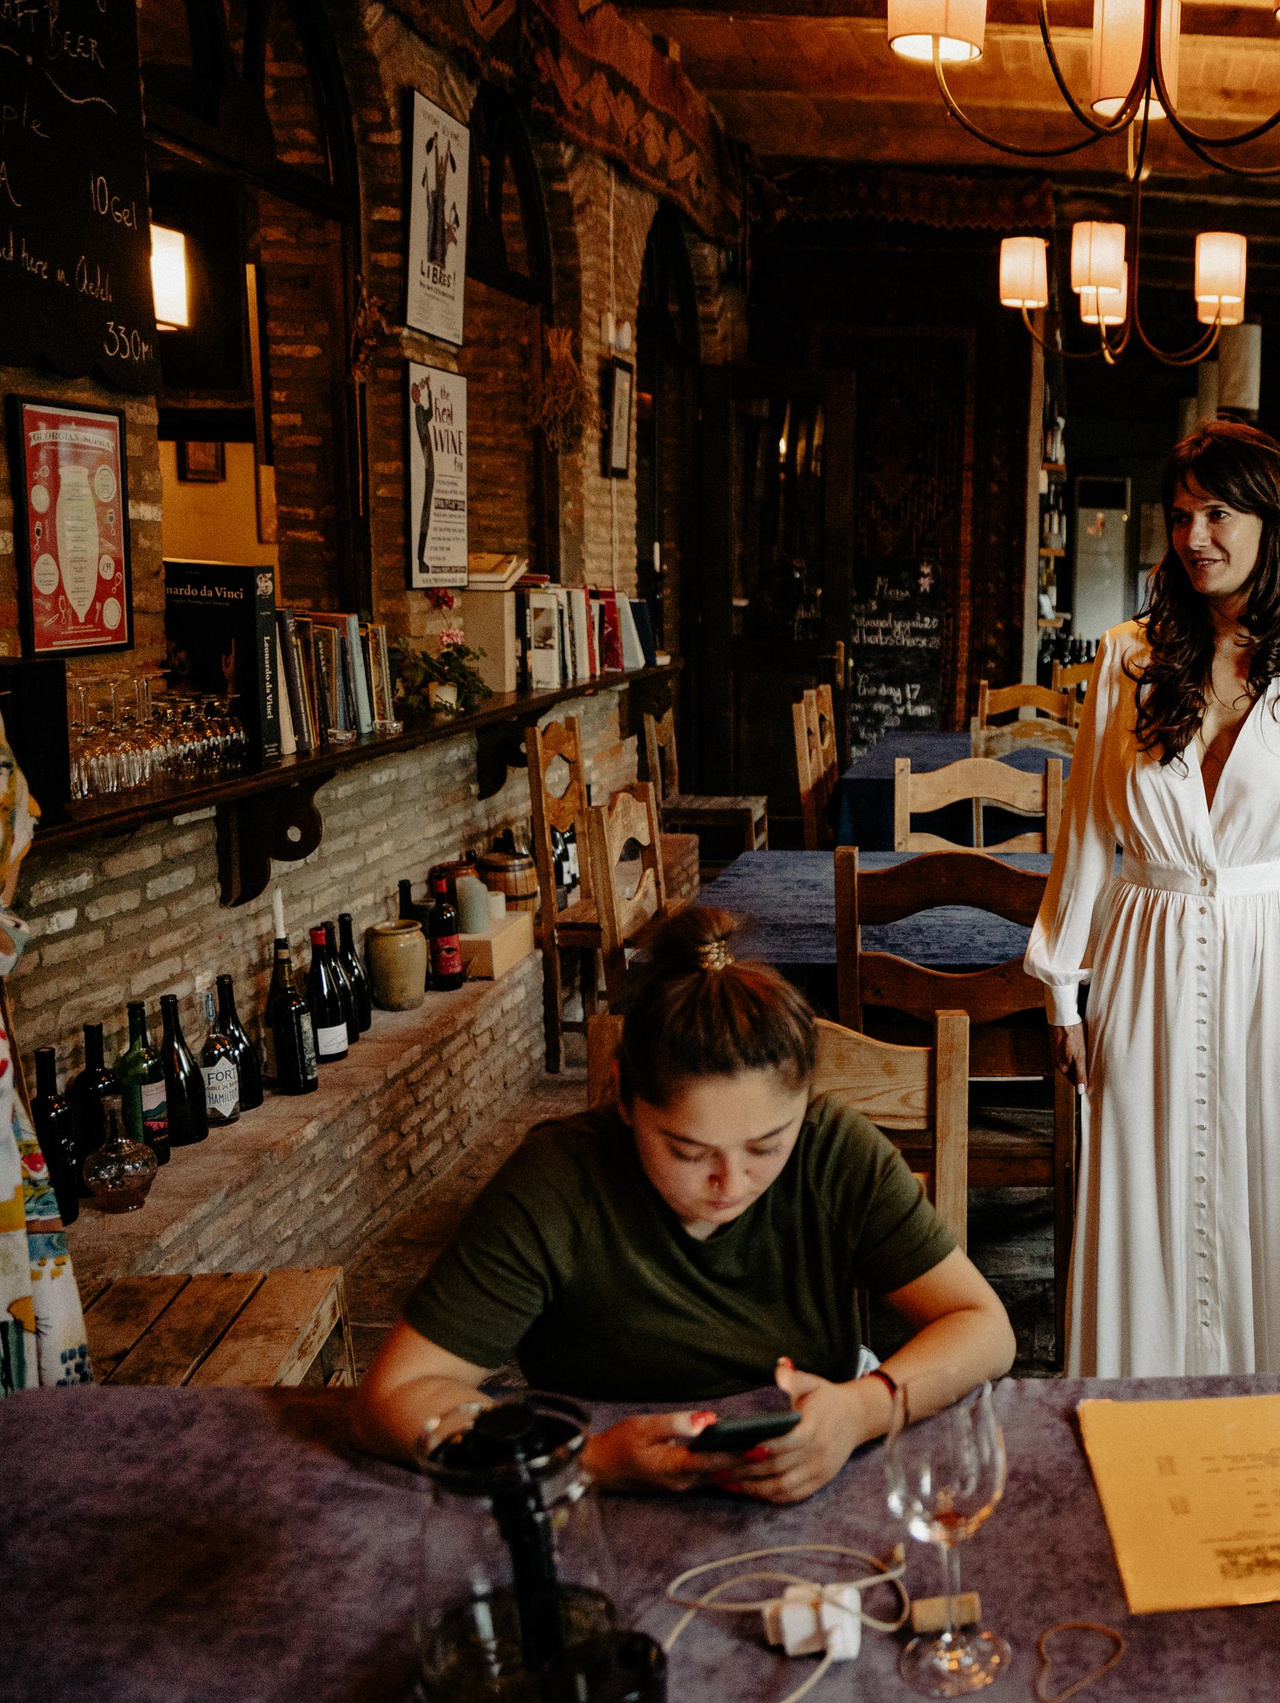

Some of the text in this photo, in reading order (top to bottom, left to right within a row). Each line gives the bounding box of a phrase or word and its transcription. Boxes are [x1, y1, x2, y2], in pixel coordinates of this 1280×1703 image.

[91, 171, 138, 231] 10 Gel
[434, 397, 454, 426] Real
[433, 425, 464, 456] WINE
[200, 585, 213, 597] da
[214, 586, 244, 599] Vinci
[263, 635, 274, 720] Leonardo da Vinci
[904, 683, 921, 700] 17
[207, 1068, 236, 1086] FORT
